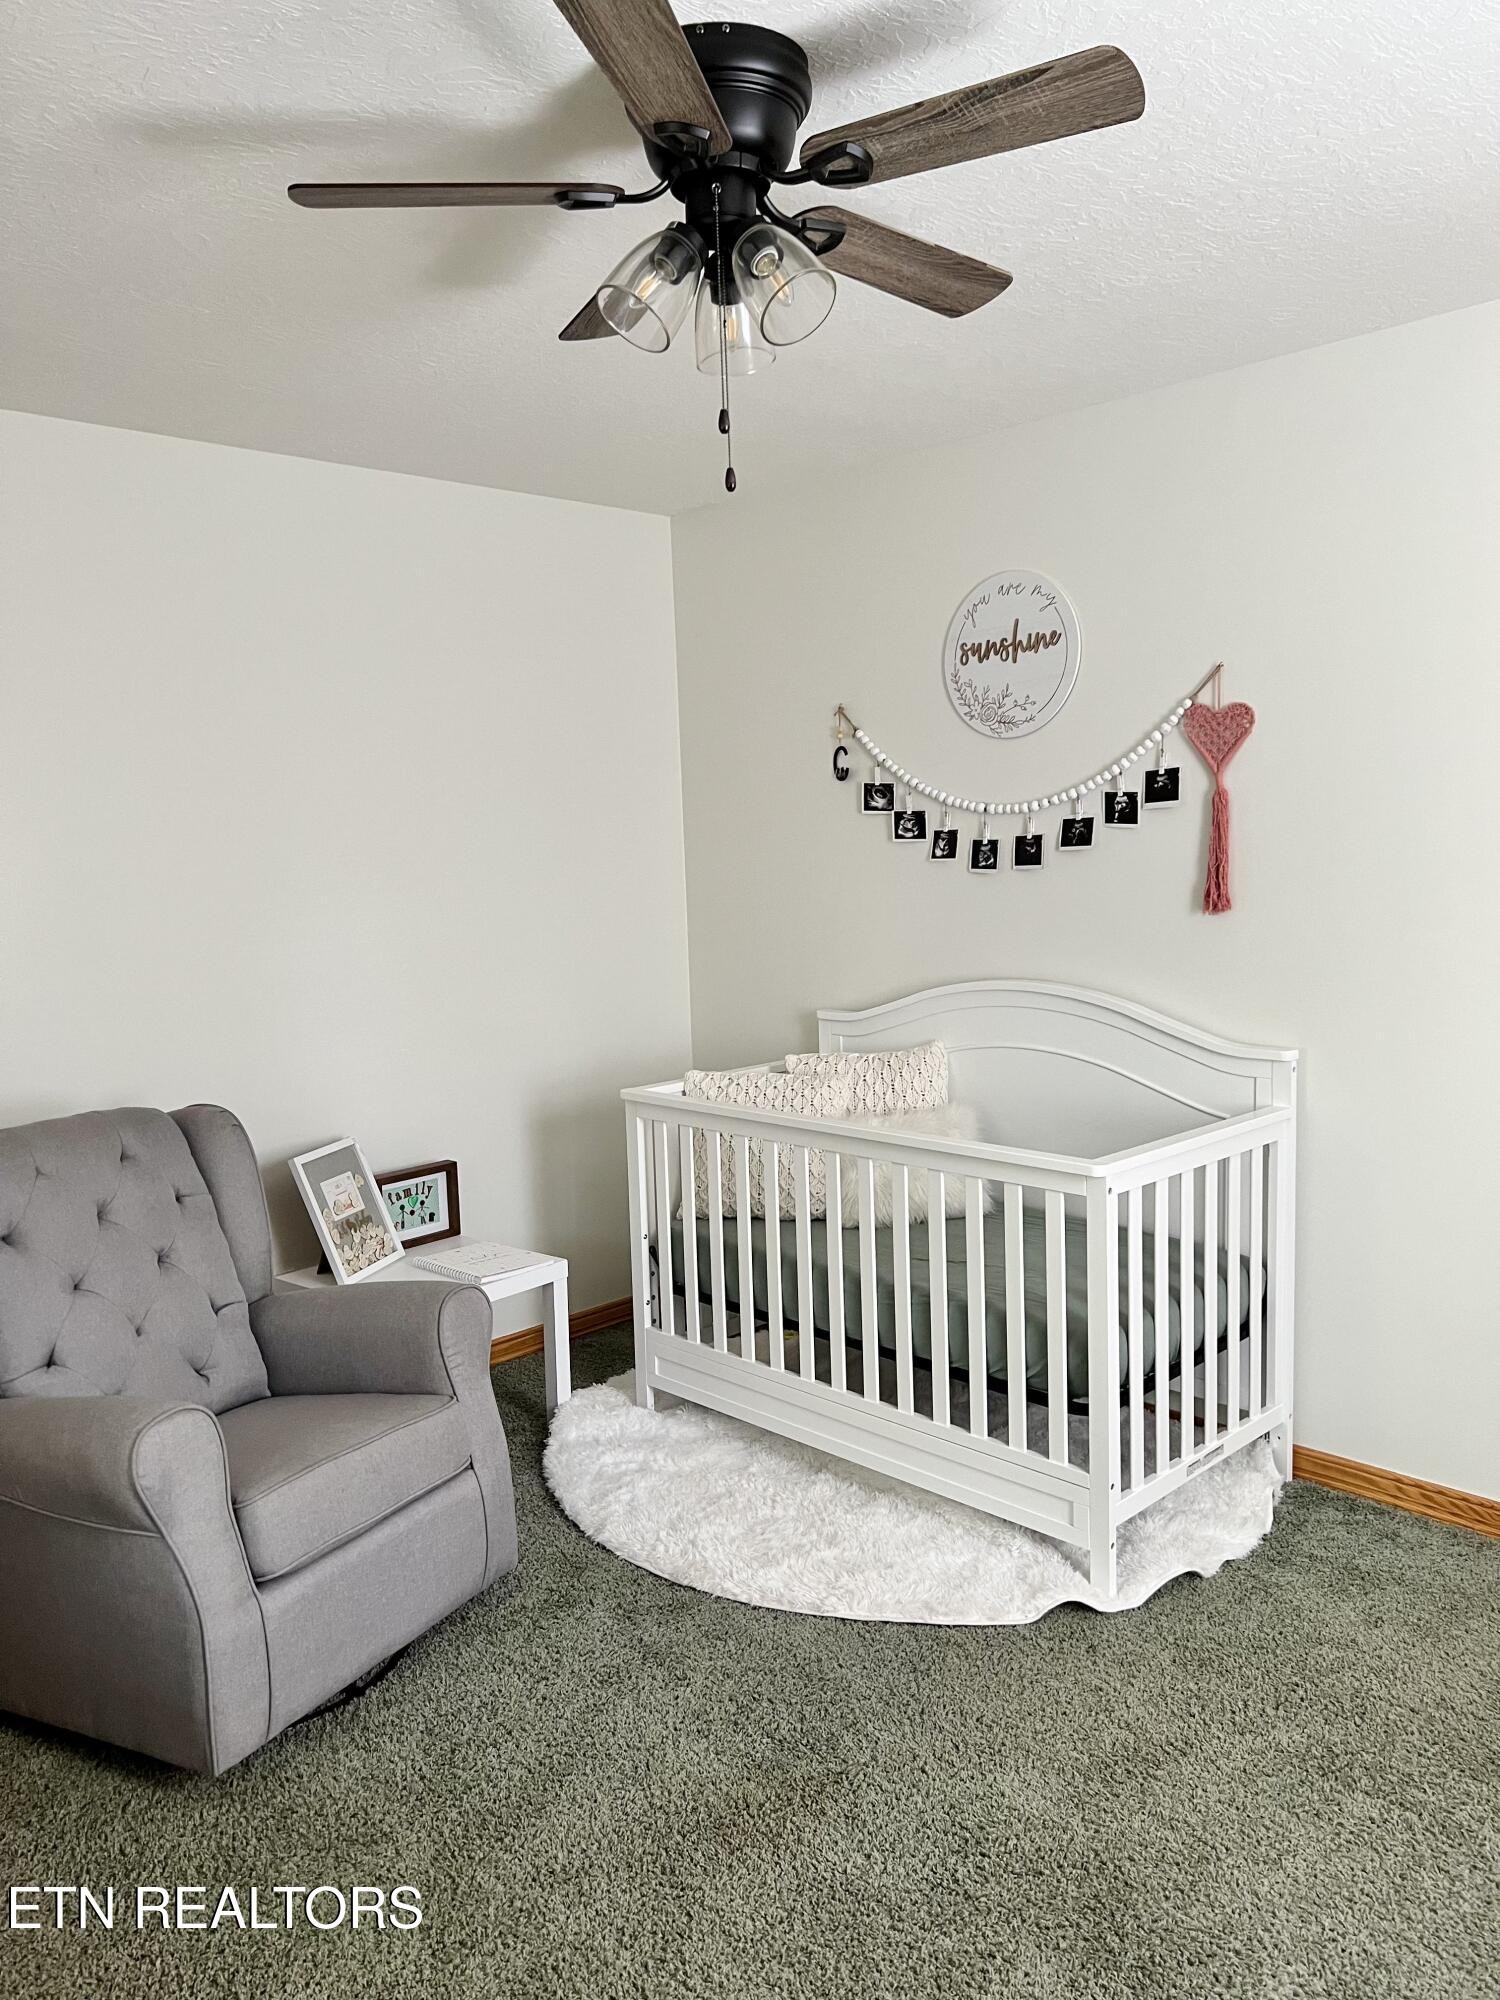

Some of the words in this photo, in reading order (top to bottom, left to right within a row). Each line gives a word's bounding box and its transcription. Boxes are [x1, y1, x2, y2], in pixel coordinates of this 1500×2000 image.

[964, 594, 991, 629] you
[998, 582, 1026, 597] are
[1030, 584, 1057, 612] my
[959, 618, 1062, 666] sunshine
[387, 1181, 433, 1206] family
